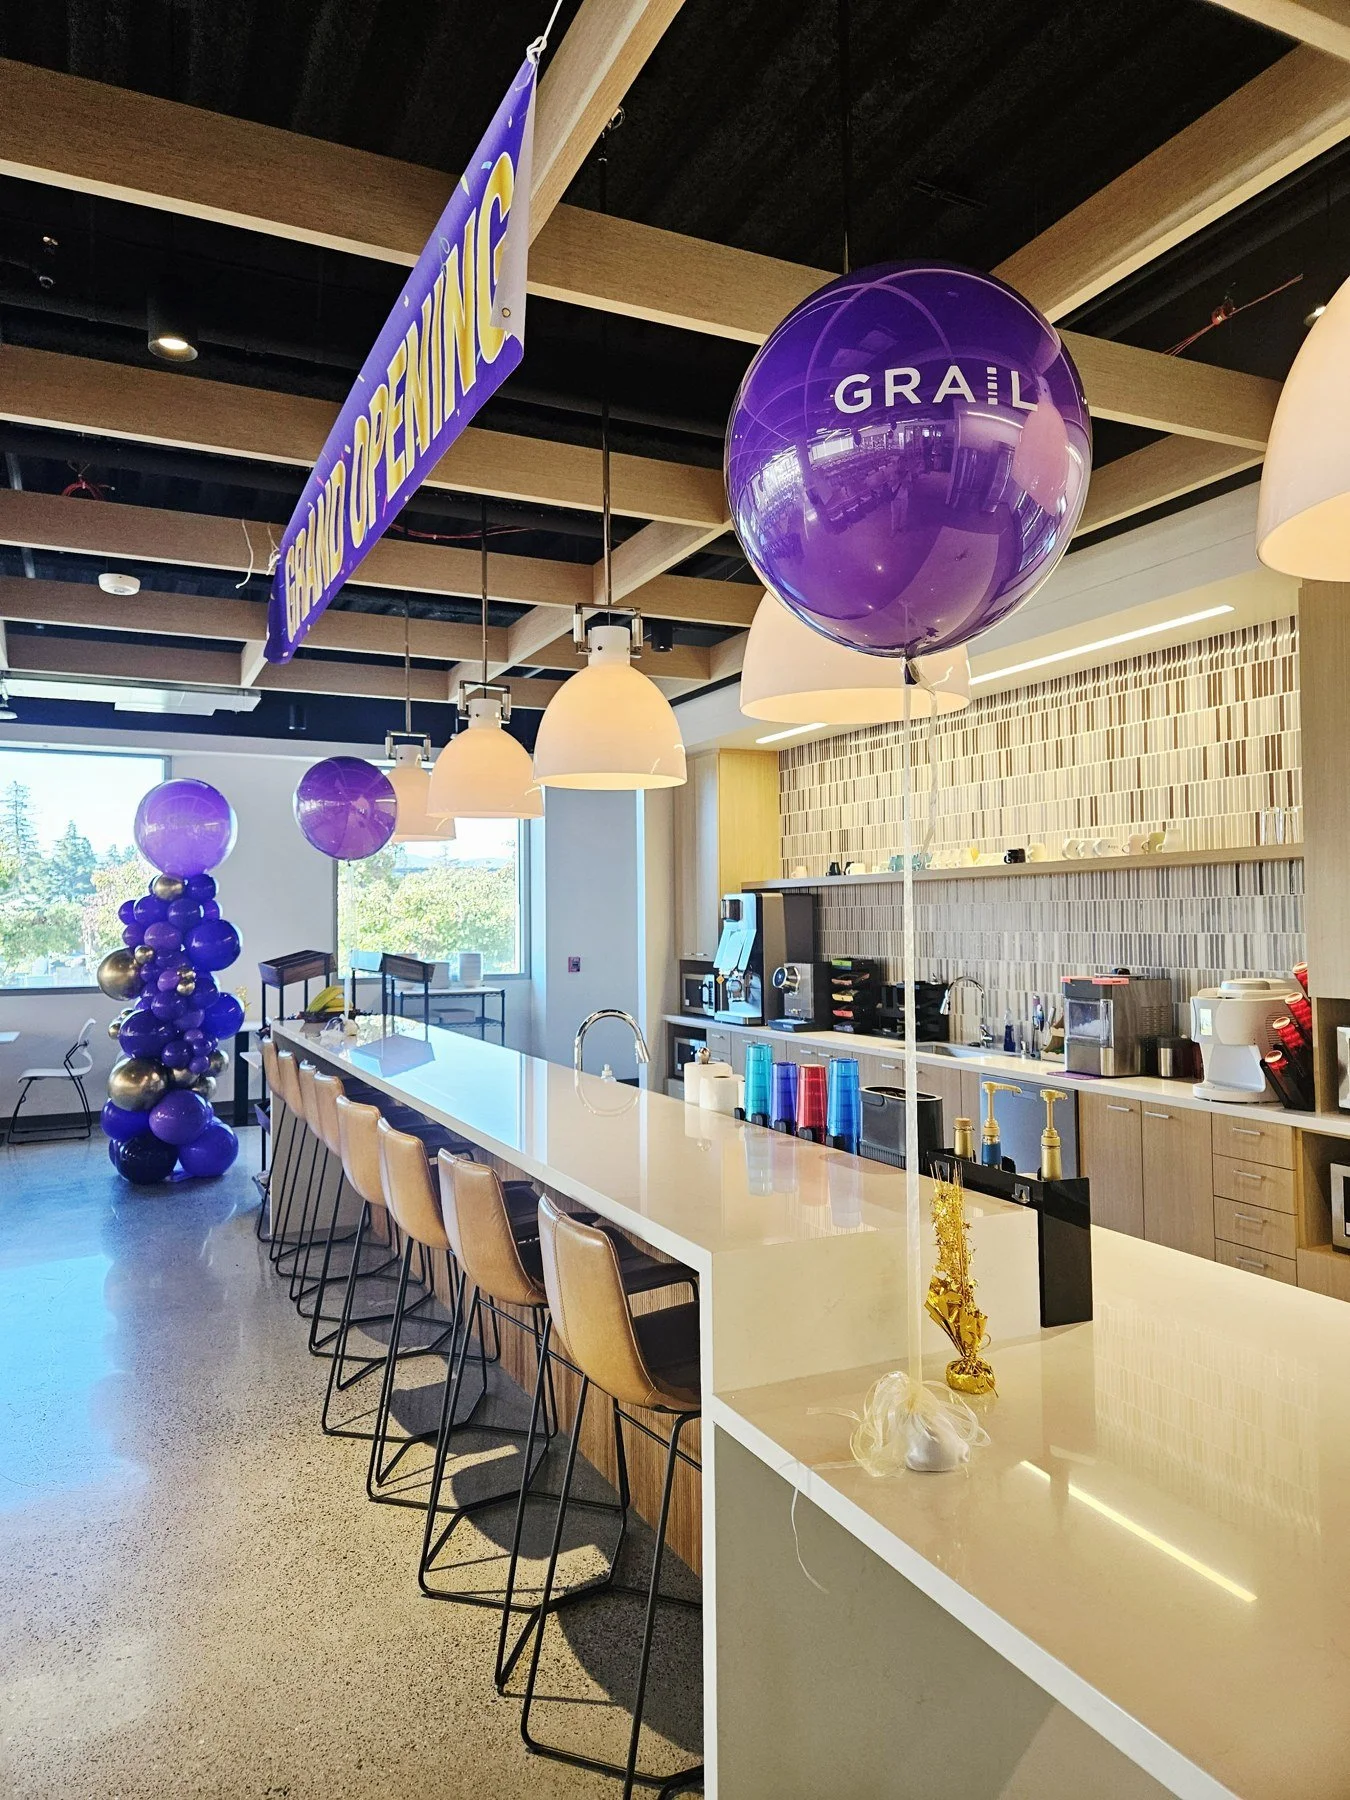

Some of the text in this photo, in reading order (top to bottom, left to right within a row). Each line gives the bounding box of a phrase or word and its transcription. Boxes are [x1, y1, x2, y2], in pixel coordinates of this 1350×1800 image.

[285, 152, 515, 643] GRAND OPENING
[834, 365, 1038, 414] GRAIL
